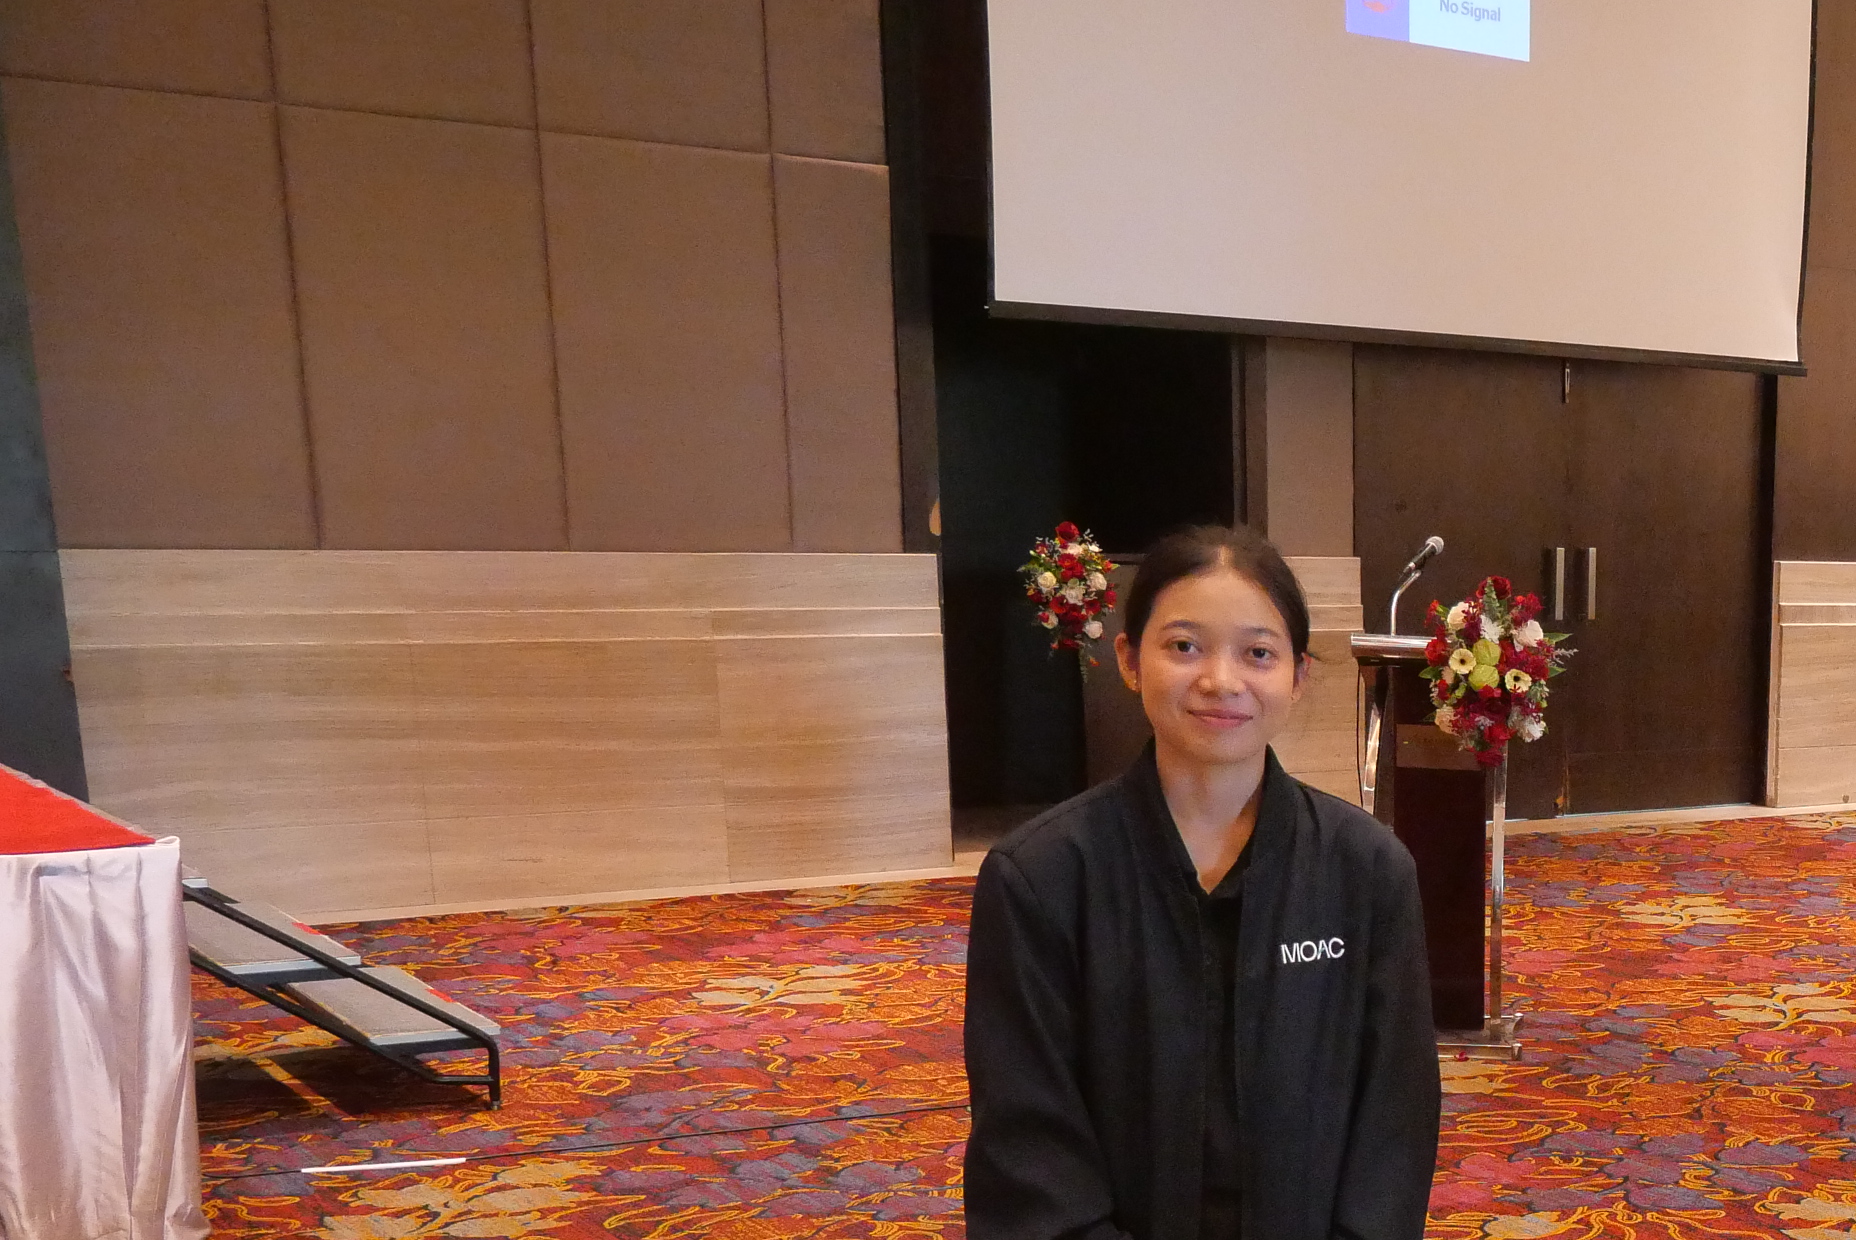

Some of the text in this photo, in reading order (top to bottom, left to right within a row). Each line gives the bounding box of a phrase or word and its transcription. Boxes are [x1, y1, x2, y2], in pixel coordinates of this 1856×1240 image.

[1439, 0, 1501, 22] No Signal
[1280, 936, 1346, 965] MOAC
